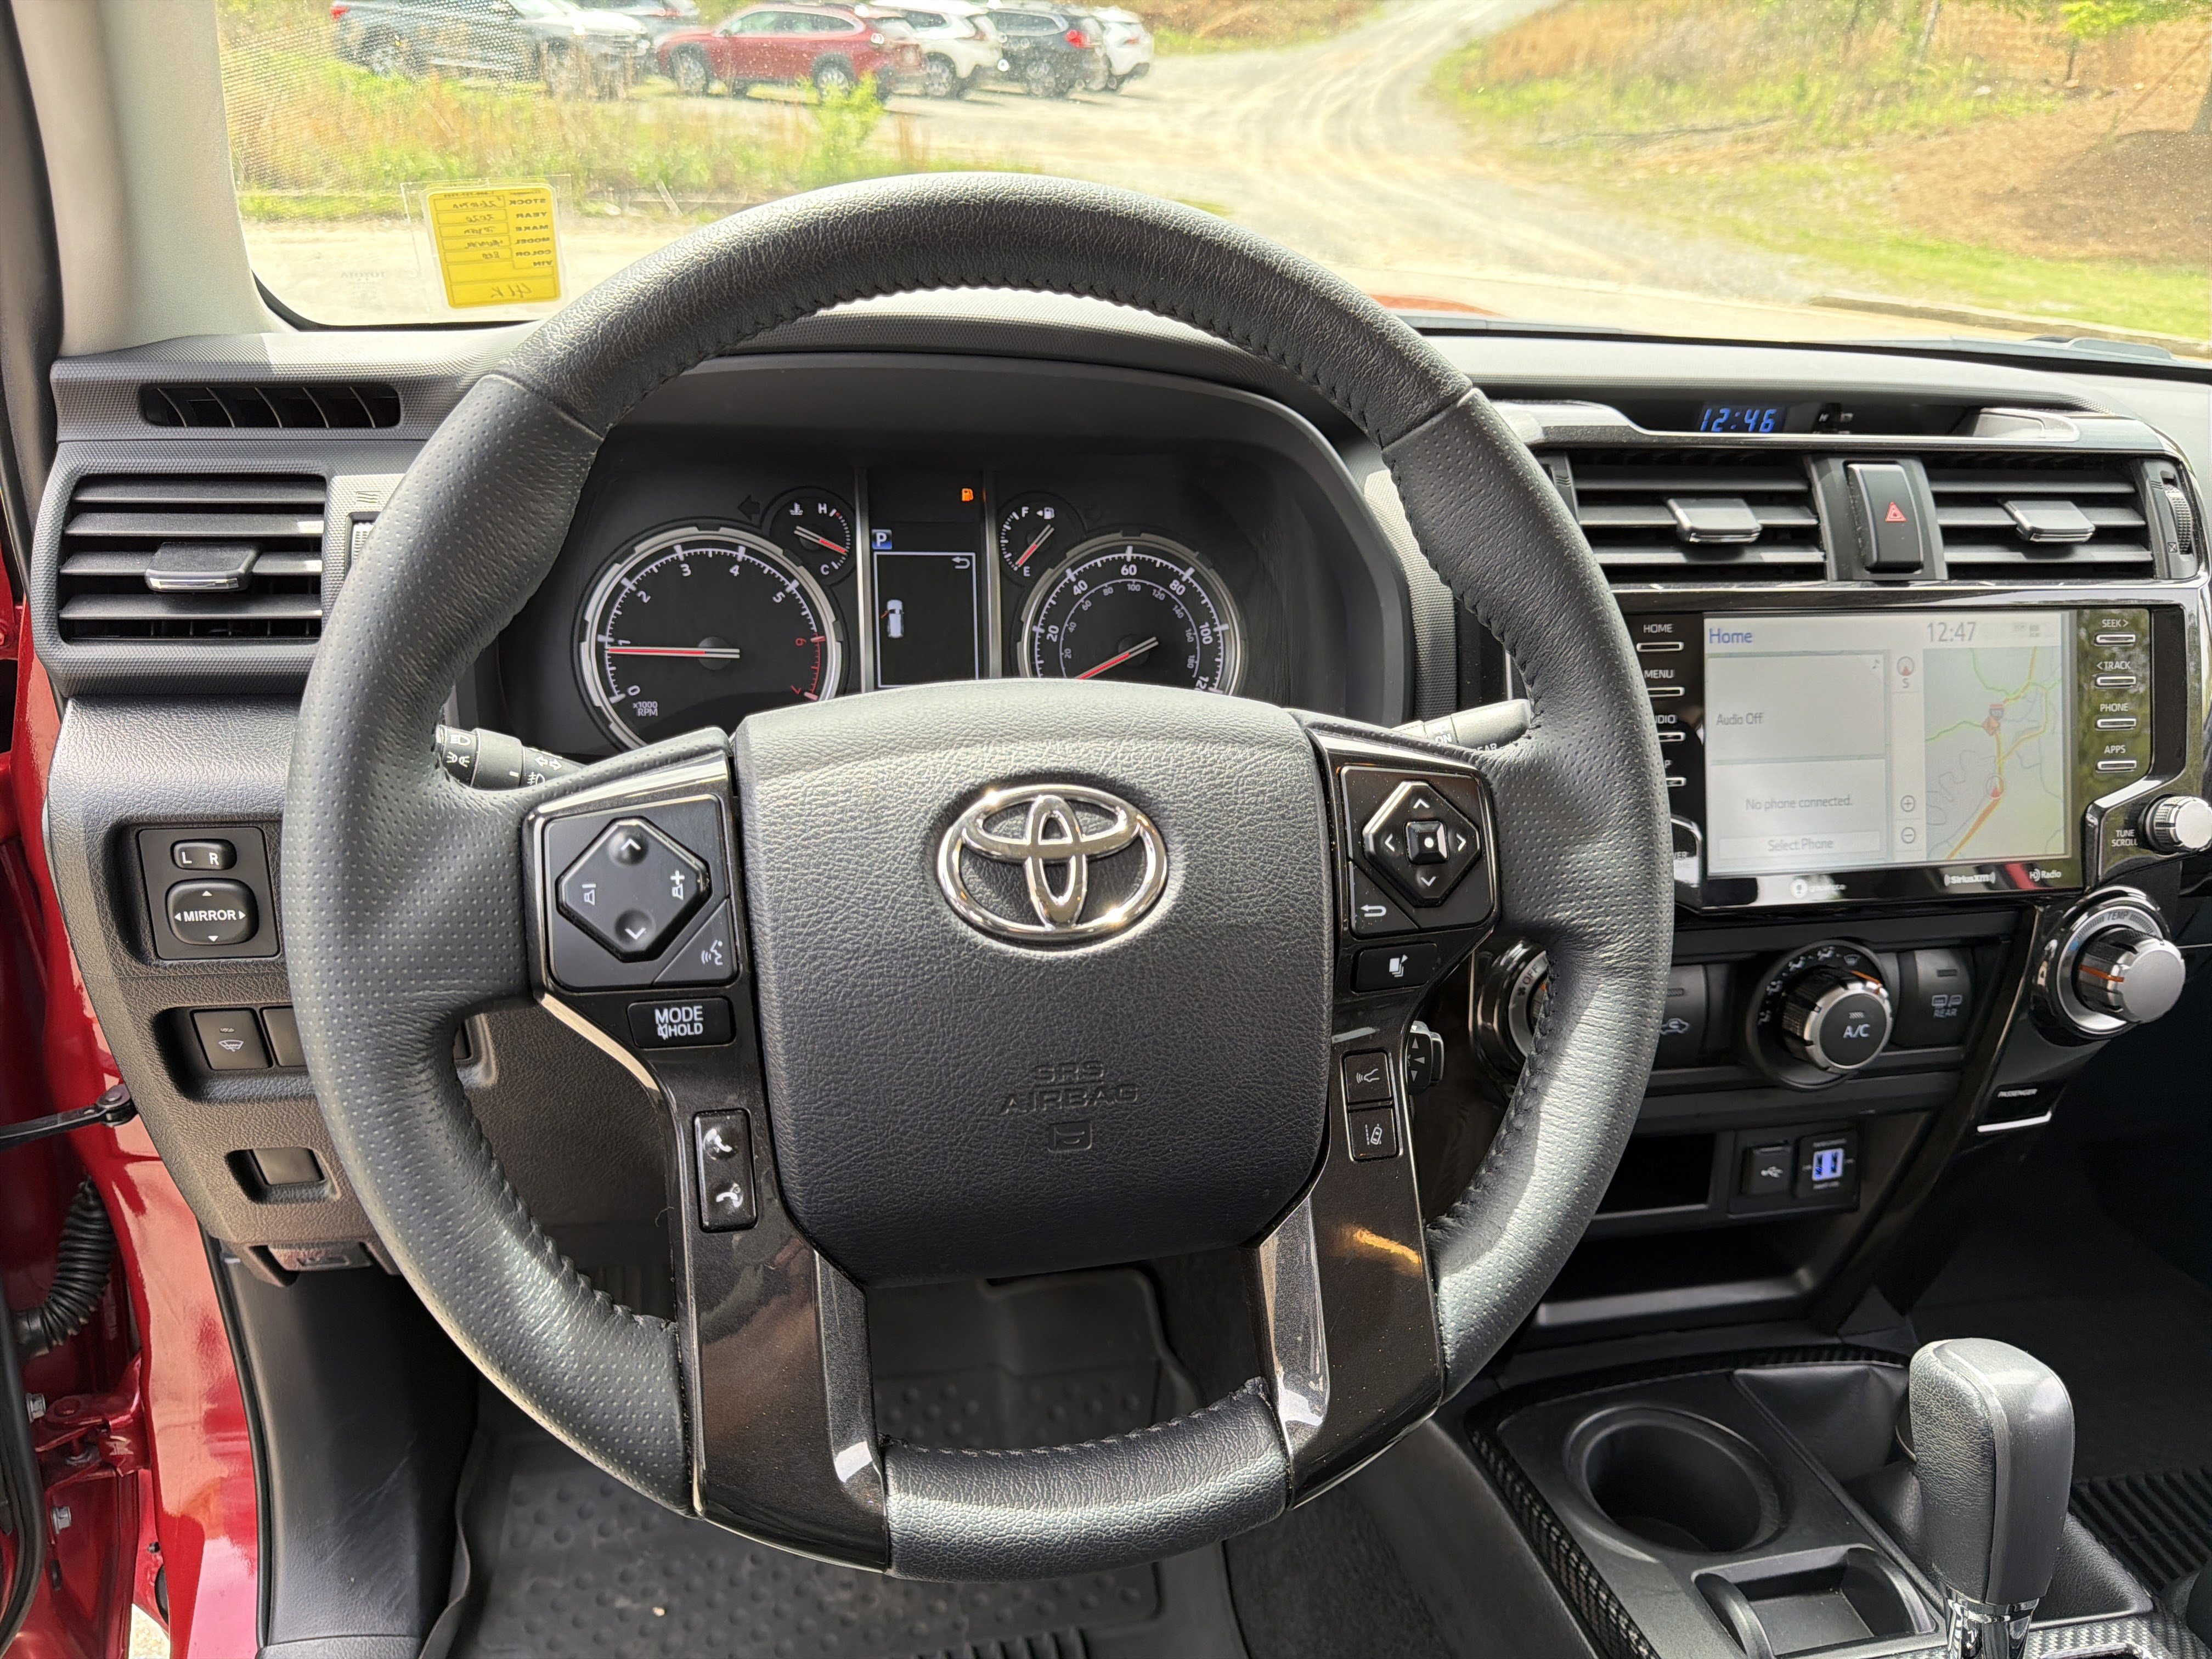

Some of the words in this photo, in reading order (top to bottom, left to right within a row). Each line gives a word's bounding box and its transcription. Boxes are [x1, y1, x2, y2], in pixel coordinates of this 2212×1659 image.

[1701, 408, 1777, 432] 12:46
[818, 504, 827, 514] H
[1021, 506, 1029, 517] F
[877, 532, 887, 548] P
[680, 564, 691, 577] 3
[729, 565, 740, 577] 4
[821, 565, 830, 575] C
[1023, 566, 1031, 577] E
[1121, 565, 1137, 575] 60
[1073, 579, 1088, 595] 40
[1103, 586, 1114, 596] 80
[1127, 583, 1141, 592] 100
[1169, 579, 1186, 595] 80
[637, 590, 651, 603] 2
[772, 591, 786, 603] 5
[1152, 588, 1166, 601] 120
[1081, 599, 1092, 611] 60
[1172, 605, 1184, 619] 140
[1047, 625, 1059, 642] 20
[1068, 622, 1077, 634] 40
[1199, 622, 1213, 645] 100
[1643, 623, 1673, 634] HOME
[1927, 621, 1976, 642] 12:47
[1185, 628, 1194, 643] 160
[1708, 628, 1753, 645] Home
[1064, 648, 1072, 659] 20
[1187, 655, 1195, 669] 180
[1644, 669, 1675, 679] MENU
[1194, 676, 1209, 691] 12
[627, 685, 640, 696] 0
[637, 708, 658, 716] RPM
[2100, 703, 2129, 712] PHONE
[1716, 713, 1743, 726] Audio
[1746, 713, 1763, 725] Off
[2104, 745, 2126, 754] APPS
[1746, 799, 1762, 810] No
[1764, 798, 1796, 812] phone
[1799, 795, 1853, 808] connected.
[2116, 829, 2135, 838] TUNE
[1768, 838, 1798, 851] Select
[1801, 837, 1833, 850] Phone
[2111, 838, 2138, 848] SCROLL
[182, 852, 192, 864] L
[209, 853, 219, 865] R
[2041, 870, 2062, 878] Radio
[183, 910, 236, 922] MIRROR
[2107, 911, 2129, 921] TEMP
[654, 1006, 704, 1024] MODE
[669, 1023, 703, 1036] HOLD
[1843, 1024, 1871, 1039] A/C
[1001, 1084, 1139, 1115] AIRBAG
